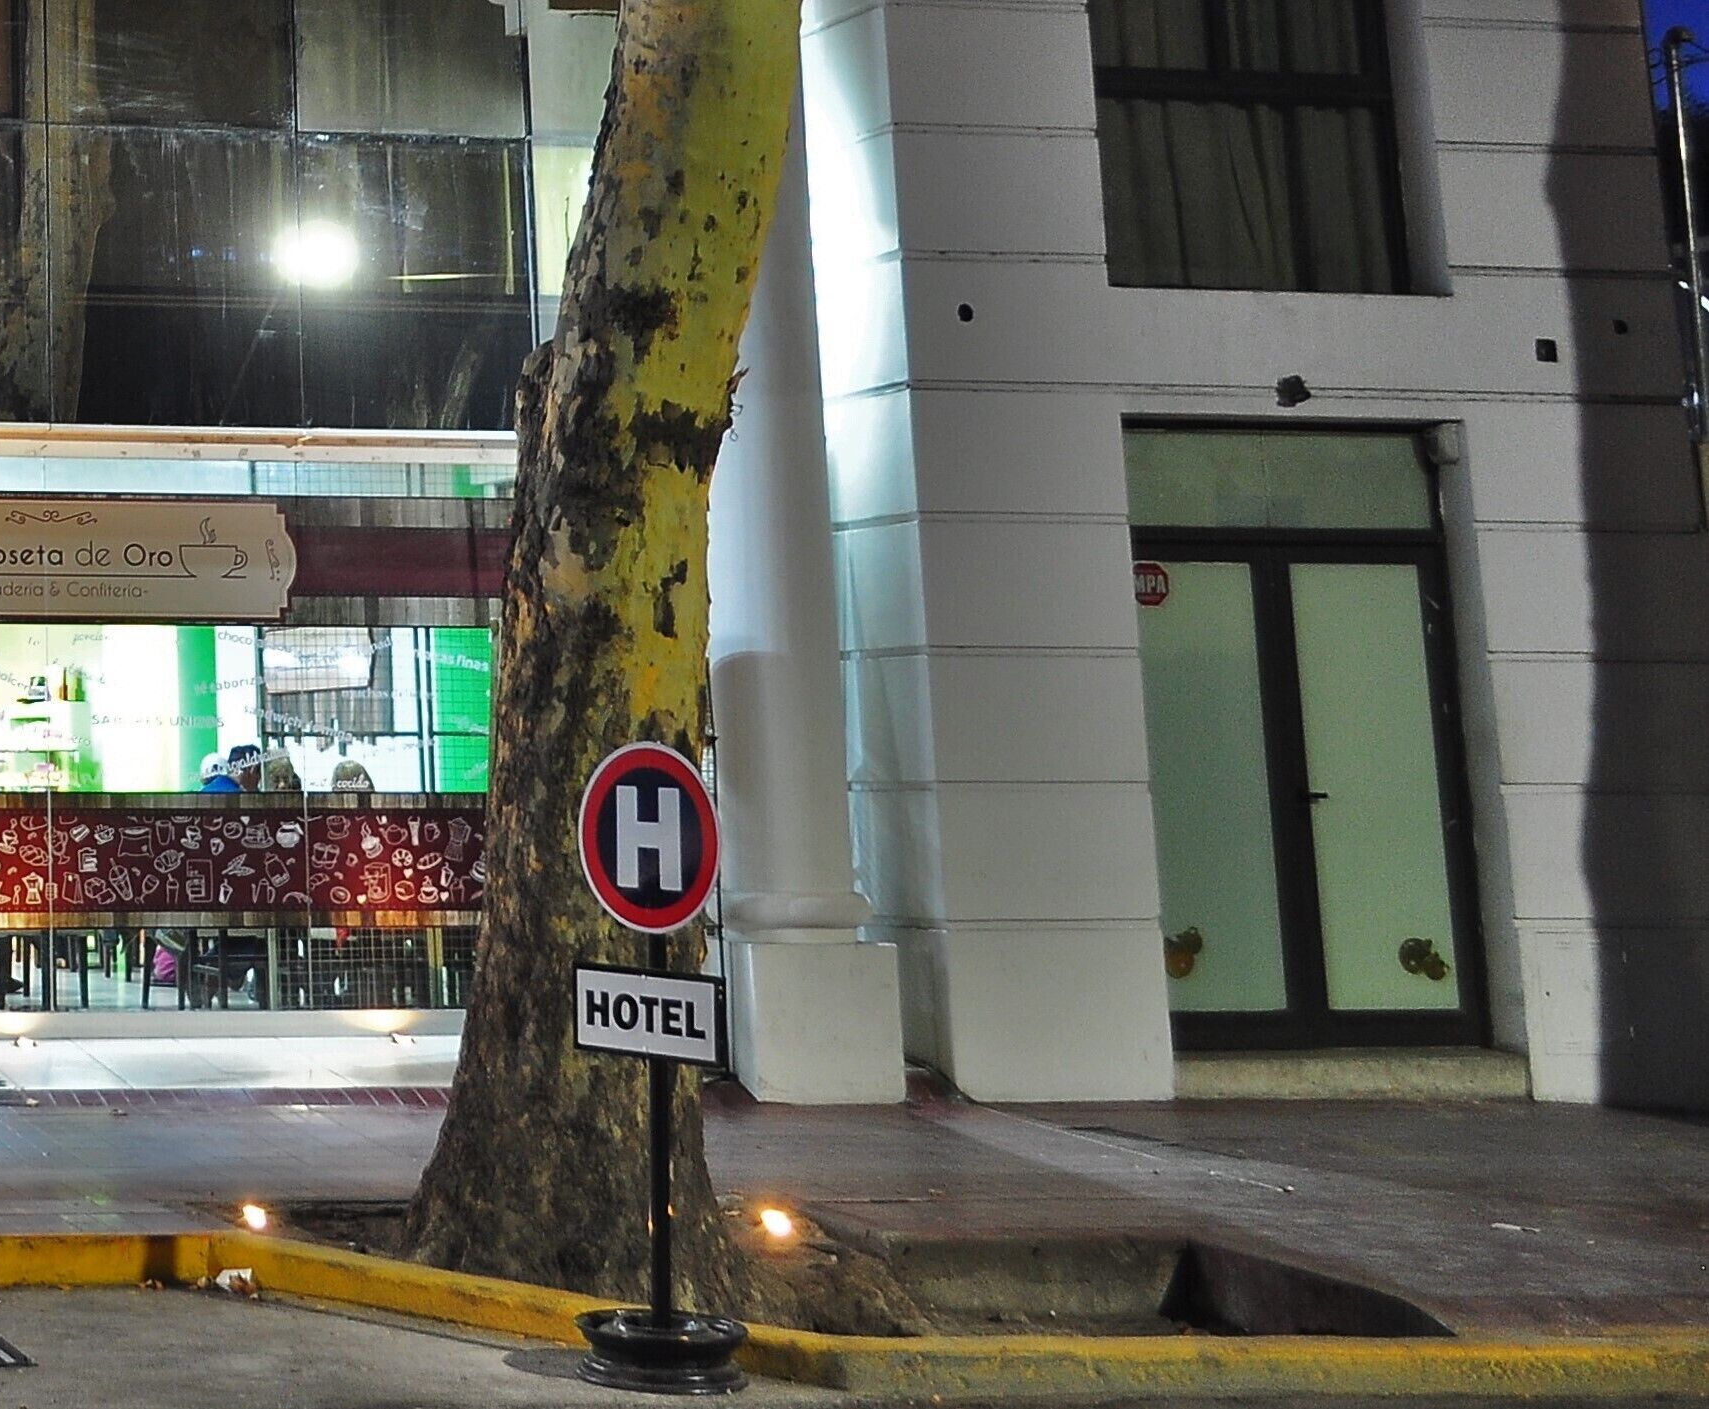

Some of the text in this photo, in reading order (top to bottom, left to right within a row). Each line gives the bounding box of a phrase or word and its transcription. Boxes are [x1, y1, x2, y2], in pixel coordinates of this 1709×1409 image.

[74, 541, 112, 568] de
[123, 543, 173, 568] Oro
[50, 582, 61, 598] &
[615, 784, 683, 891] H
[585, 989, 707, 1040] HOTEL
